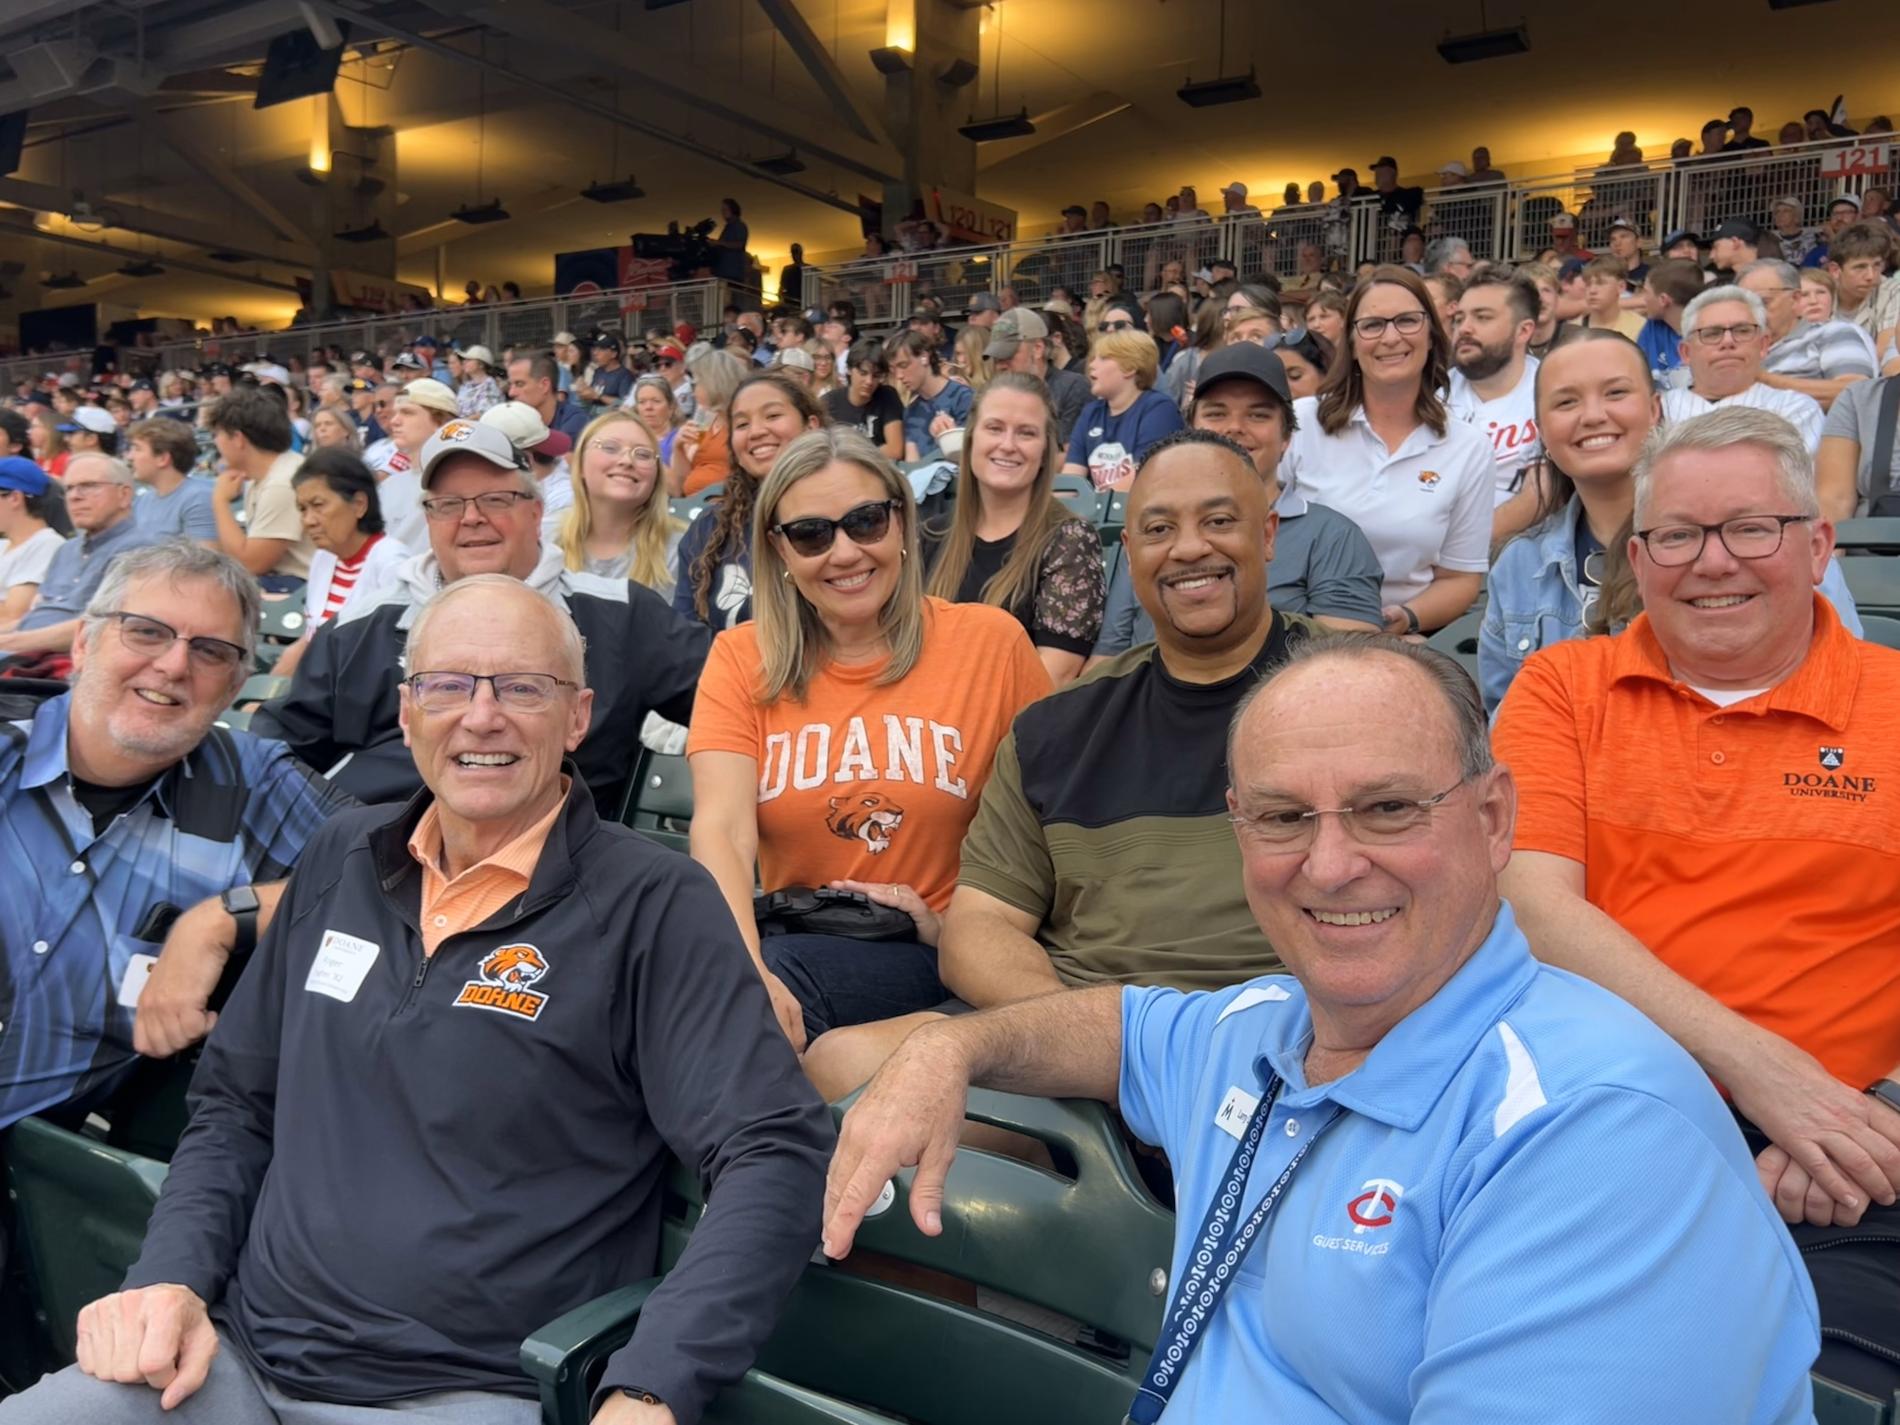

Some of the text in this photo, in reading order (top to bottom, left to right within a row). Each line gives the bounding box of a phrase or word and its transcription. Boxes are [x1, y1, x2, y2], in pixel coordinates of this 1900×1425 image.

[1836, 146, 1880, 173] 121
[758, 714, 968, 804] DOANE
[1783, 773, 1877, 793] DOANE
[1790, 788, 1867, 803] UNIVERSITY
[459, 985, 542, 1016] DOANE
